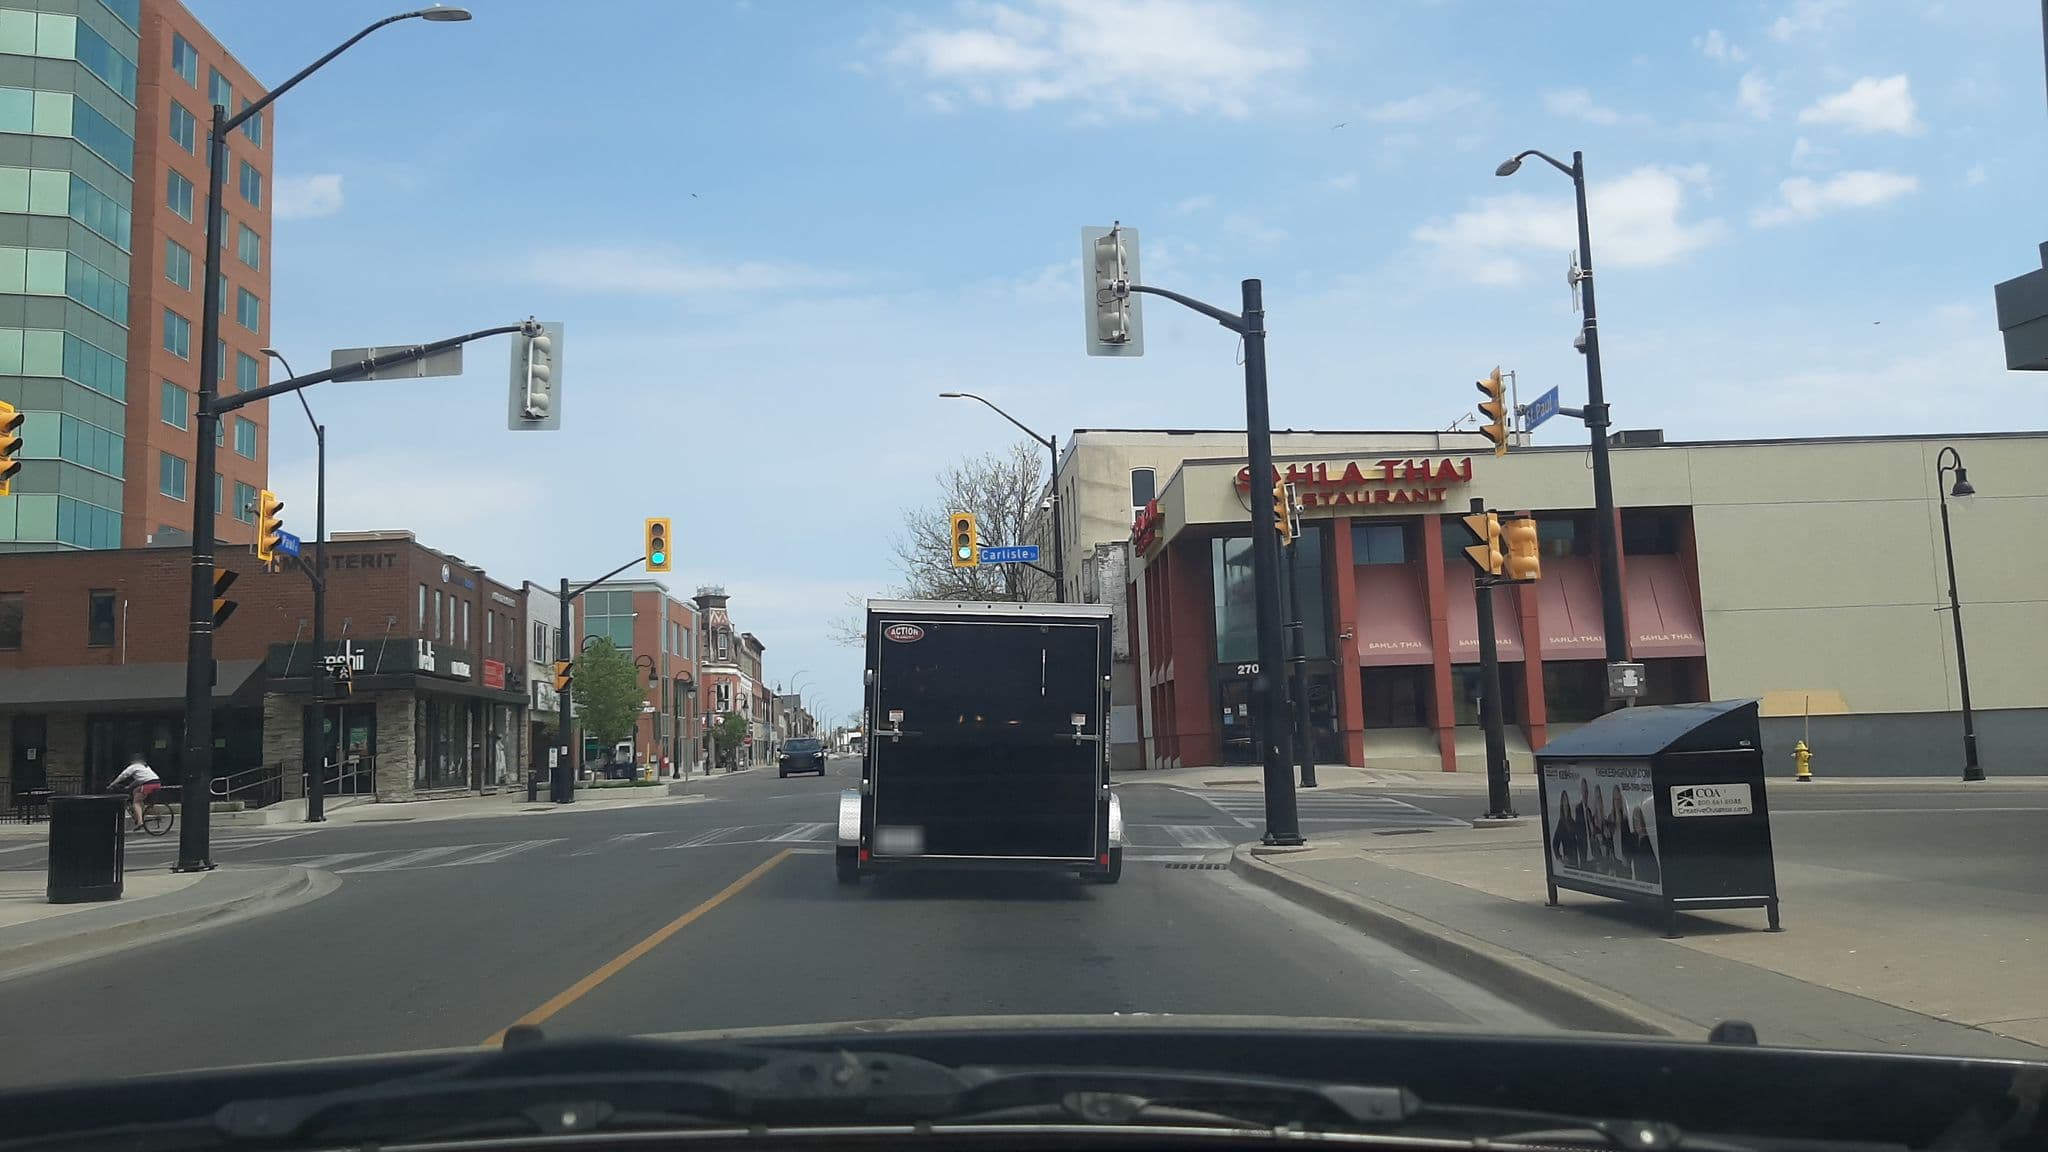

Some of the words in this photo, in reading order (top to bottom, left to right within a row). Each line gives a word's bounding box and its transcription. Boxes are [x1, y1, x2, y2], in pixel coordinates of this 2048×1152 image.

[1536, 394, 1553, 420] Paul
[1376, 457, 1473, 485] THAI
[1301, 488, 1448, 506] STAURANT
[982, 549, 1029, 560] Carlisle
[890, 627, 919, 636] ACTION
[1400, 641, 1422, 649] THAI
[1237, 664, 1259, 675] 270
[1696, 788, 1721, 798] COA
